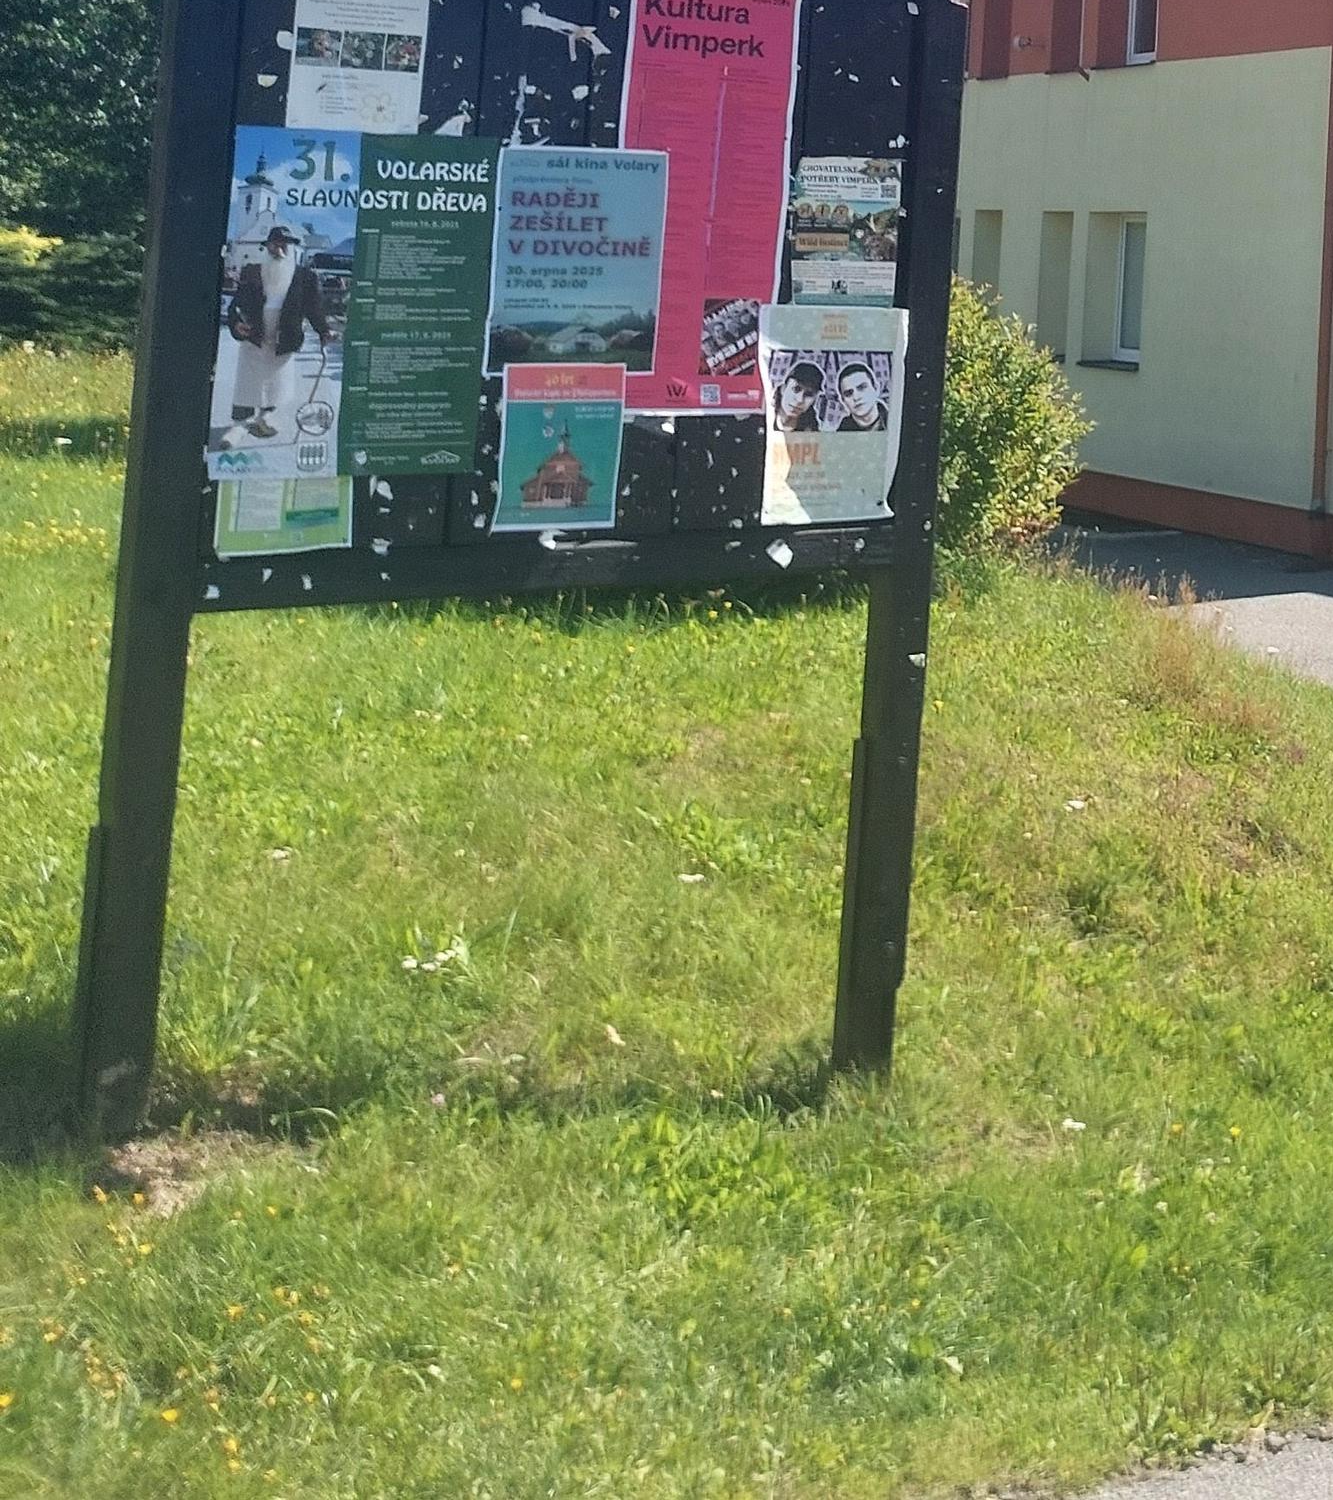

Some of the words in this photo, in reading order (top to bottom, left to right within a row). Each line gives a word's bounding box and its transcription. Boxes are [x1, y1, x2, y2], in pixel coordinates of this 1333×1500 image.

[643, 24, 764, 58] Vimperk
[289, 138, 350, 182] 31.
[377, 156, 490, 183] VOLARSKÉ
[547, 157, 569, 169] sál
[614, 159, 660, 173] Volary
[286, 187, 409, 211] SLAVNOSTI
[417, 186, 487, 213] DŘEVA
[511, 187, 600, 208] RADĚJI
[509, 210, 609, 232] ZEŠÍLET
[508, 239, 525, 255] V
[533, 236, 652, 257] DIVOČINĚ
